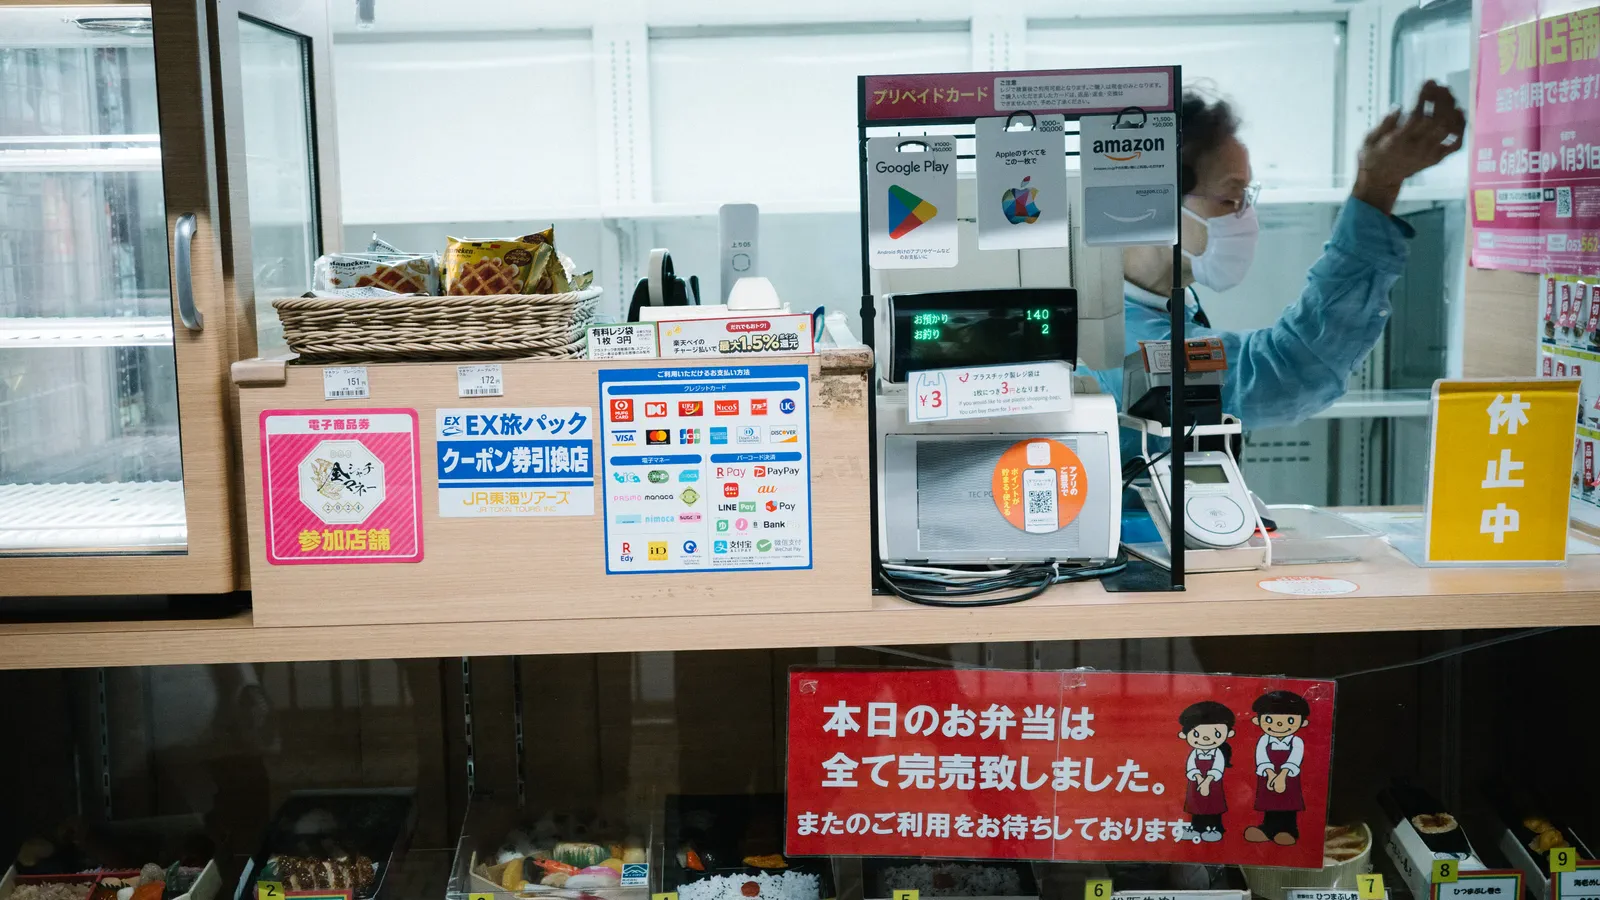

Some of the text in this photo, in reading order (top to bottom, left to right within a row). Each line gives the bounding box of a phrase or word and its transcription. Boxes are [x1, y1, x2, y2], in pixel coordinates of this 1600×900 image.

[873, 86, 988, 105] プリペイドカード
[1093, 137, 1165, 154] amazon
[995, 149, 1047, 158] Appleのすべてを
[1005, 157, 1037, 166] この一枚で
[875, 160, 949, 176] Google Play
[914, 313, 949, 325] お預かり
[1026, 309, 1049, 320] 140
[592, 326, 634, 337] 有料レジ袋
[914, 329, 940, 340] お釣り
[1041, 324, 1049, 334] 2
[597, 337, 611, 345] 1枚
[616, 335, 631, 344] 3円
[673, 338, 705, 347] 楽天ペイの
[673, 346, 717, 354] チャージ払いで
[657, 368, 750, 378] ご利用いただけるお支払い方法
[973, 370, 1040, 381] プラスチック製レジ袋は
[684, 384, 727, 392] クレジットカード
[931, 390, 942, 408] 3
[646, 403, 665, 416] DC
[780, 401, 795, 411] UC
[308, 418, 371, 431] 電子商品券
[444, 416, 460, 426] EX
[466, 412, 588, 437] EX旅パック
[615, 434, 634, 442] VISA
[442, 446, 589, 474] クーポン券引換店
[641, 456, 670, 464] 電子マネー
[727, 467, 746, 478] Pay
[767, 466, 800, 477] PayPay
[1480, 393, 1531, 544] 休止中
[758, 485, 776, 493] au
[463, 490, 571, 506] JR東海ツアーズ
[780, 502, 795, 512] Pay
[645, 515, 675, 523] nimoca
[763, 520, 785, 528] Bank
[298, 528, 391, 552] 参加店舗
[822, 700, 1095, 742] 本日のお弁当は
[821, 752, 1166, 795] 全て完売致しました。
[797, 810, 1201, 844] またのご利用をお待ちしております。
[1558, 851, 1567, 866] 9
[1440, 863, 1450, 877] 8
[266, 885, 276, 897] 2
[1094, 883, 1103, 897] 6
[1365, 879, 1374, 893] 7
